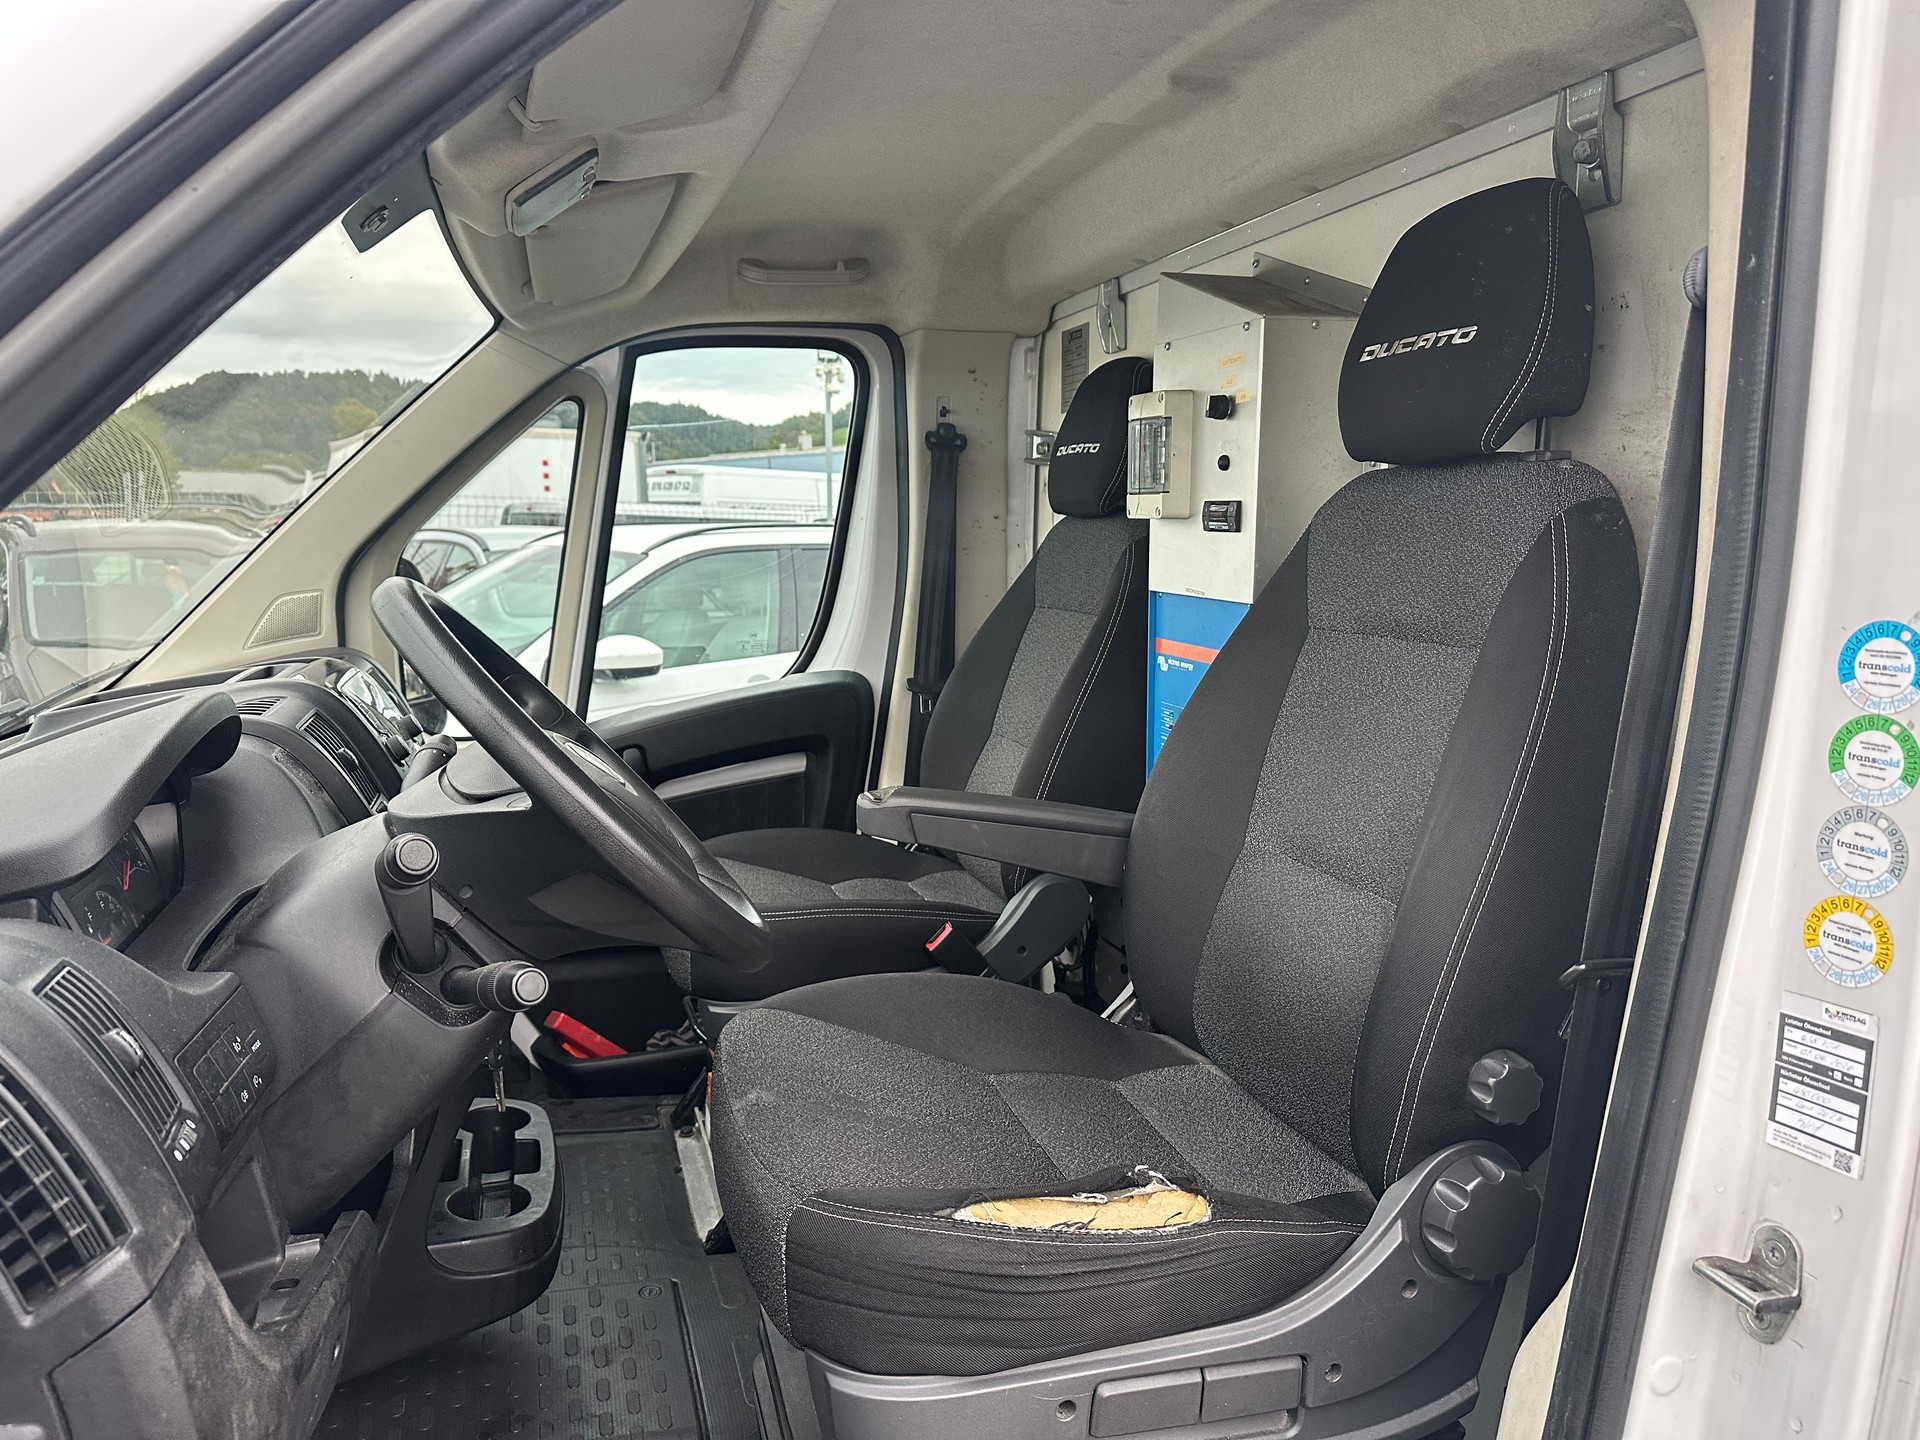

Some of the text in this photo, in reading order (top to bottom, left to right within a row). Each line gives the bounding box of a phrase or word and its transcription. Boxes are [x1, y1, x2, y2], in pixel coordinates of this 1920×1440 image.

[1359, 326, 1478, 362] DUCATO
[1056, 443, 1100, 456] DUCATO
[1846, 646, 1855, 654] 3
[1855, 636, 1862, 644] 4
[1865, 628, 1872, 637] 5
[1878, 624, 1884, 634] 6
[1891, 625, 1897, 634] 7
[1911, 639, 1920, 648] 9
[1858, 661, 1911, 673] transcold
[1856, 720, 1863, 729] 5
[1868, 717, 1875, 727] 6
[1880, 719, 1888, 728] 7
[1845, 727, 1852, 735] 4
[1836, 737, 1845, 745] 3
[1900, 734, 1910, 743] 9
[1906, 745, 1917, 757] 10
[1848, 752, 1900, 768] transcold
[1907, 760, 1916, 771] 11
[1903, 773, 1915, 784] 12
[1844, 811, 1852, 820] 5
[1856, 809, 1863, 818] 6
[1869, 811, 1877, 820] 7
[1834, 817, 1841, 825] 4
[1825, 826, 1834, 834] 3
[1837, 839, 1888, 858] transcold
[1893, 839, 1904, 851] 10
[1894, 855, 1904, 865] 11
[1890, 867, 1902, 877] 12
[1831, 900, 1838, 909] 5
[1843, 899, 1849, 908] 6
[1855, 902, 1862, 911] 7
[1821, 905, 1827, 913] 4
[1812, 914, 1821, 922] 3
[1823, 931, 1873, 952] transcold
[1879, 932, 1889, 943] 10
[1880, 946, 1889, 957] 11
[1875, 959, 1888, 969] 12
[1785, 1017, 1803, 1027] Letzter
[1856, 1017, 1866, 1025] AG
[251, 1040, 262, 1052] MODE
